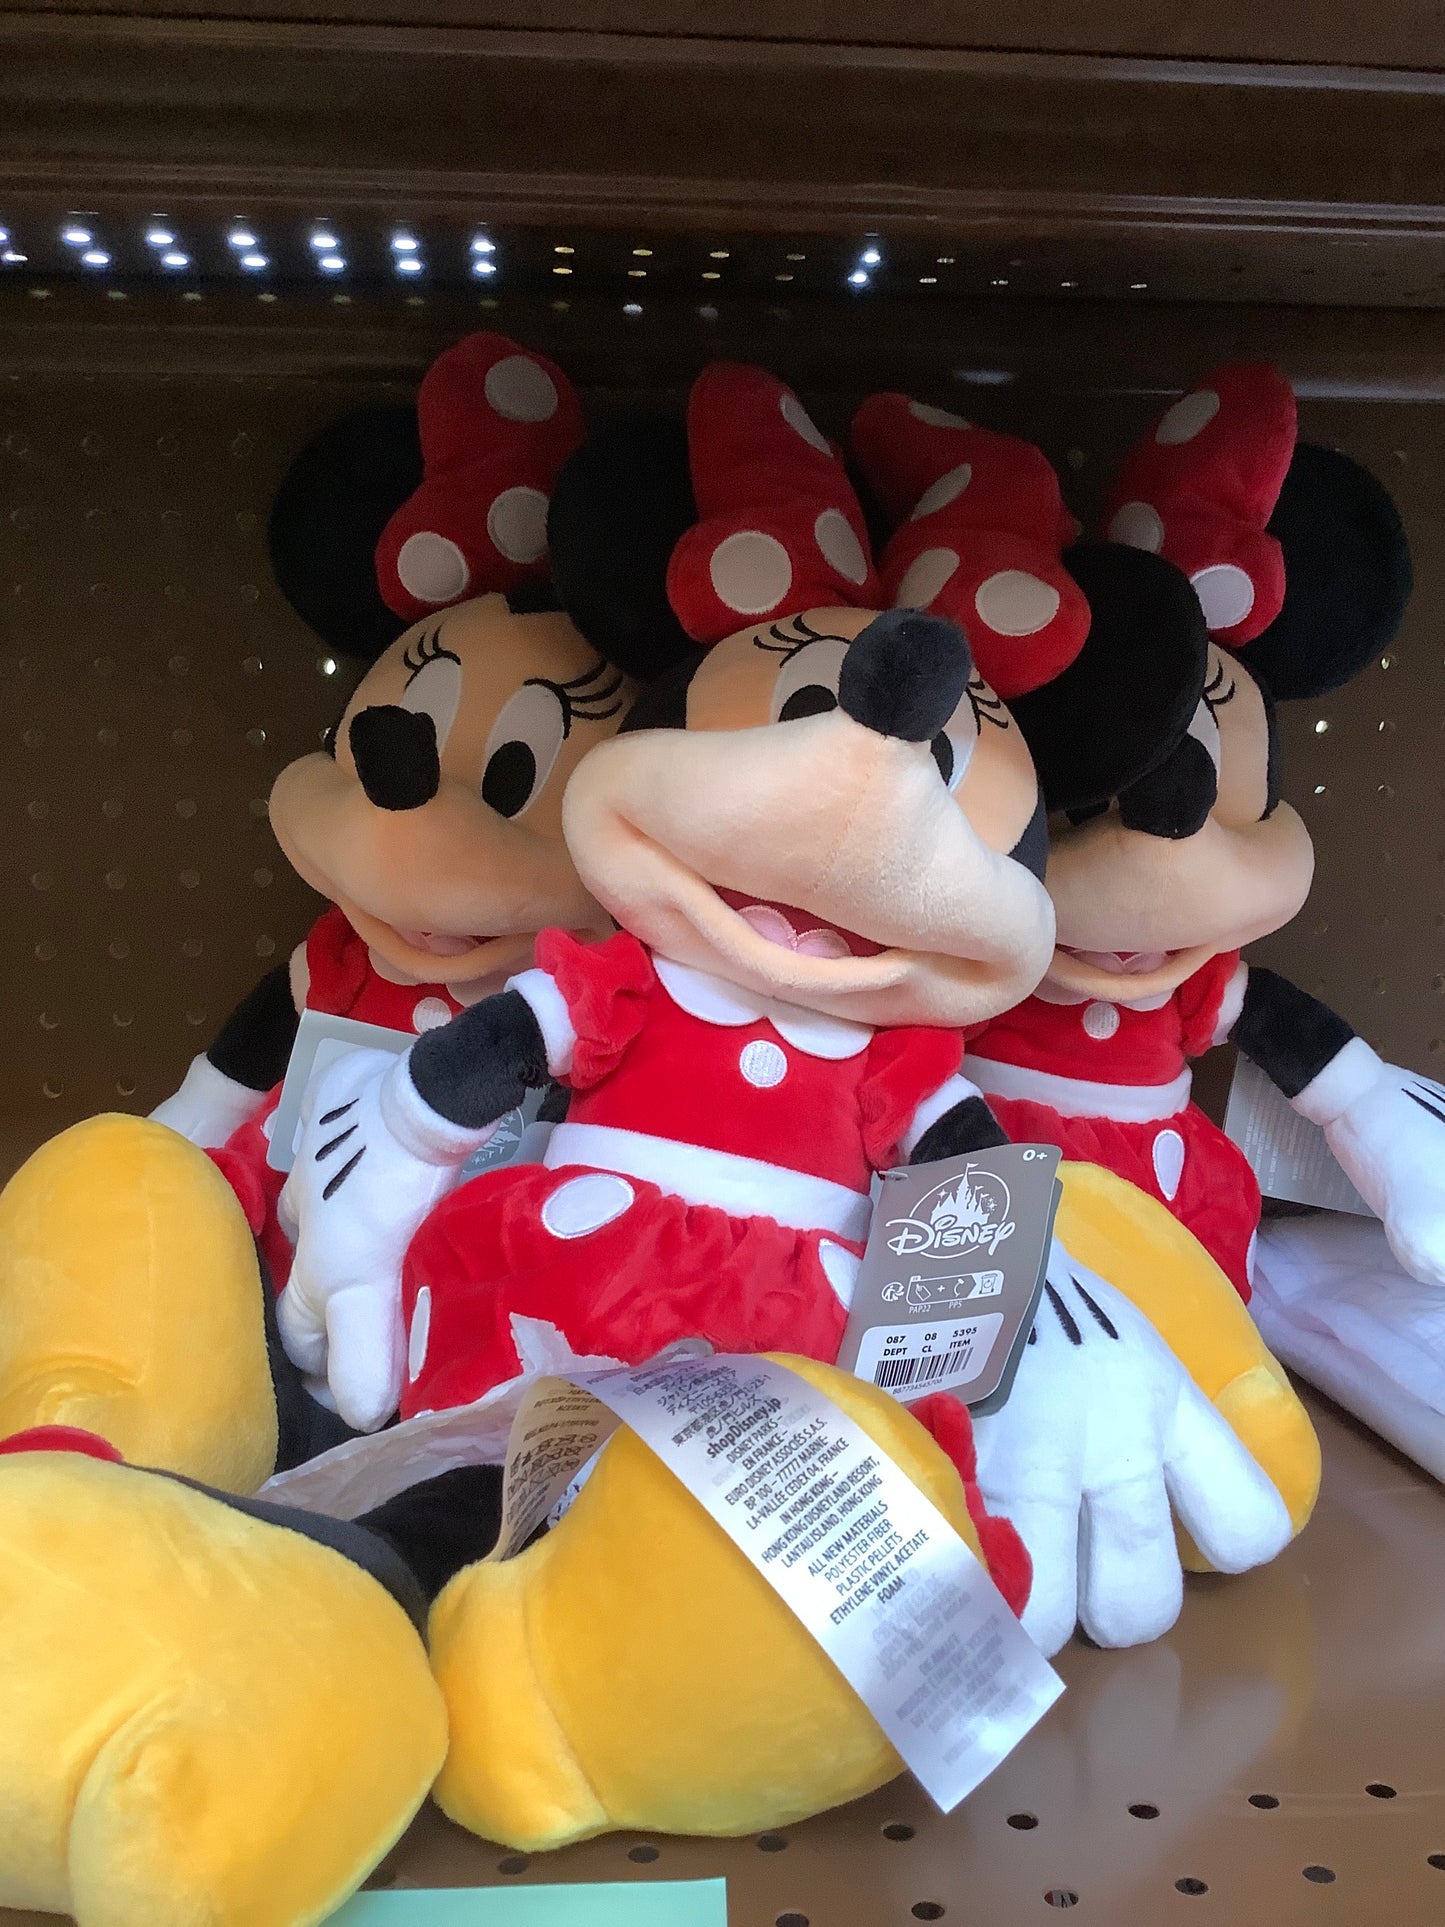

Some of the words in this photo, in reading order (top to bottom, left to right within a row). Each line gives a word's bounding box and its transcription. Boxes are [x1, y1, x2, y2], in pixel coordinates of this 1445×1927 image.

[1022, 1149, 1048, 1161] 0+
[886, 1335, 906, 1344] 087
[924, 1332, 937, 1341] 08
[952, 1327, 978, 1338] 5395
[909, 1305, 931, 1314] PAP22
[883, 1347, 908, 1357] DEPT
[922, 1345, 932, 1353] CL
[949, 1338, 971, 1349] ITEM
[706, 1398, 781, 1459] shopDisney.jp
[726, 1436, 755, 1464] DISNEY
[751, 1418, 779, 1442] PARKS
[741, 1456, 757, 1471] EN
[752, 1432, 785, 1462] FRANCE
[724, 1483, 749, 1506] EURO
[744, 1460, 774, 1489] DISNEY
[803, 1418, 827, 1439] S.A.S.
[743, 1495, 757, 1511] BP
[754, 1483, 773, 1500] 100
[775, 1457, 801, 1483] 77777
[784, 1471, 811, 1496] CEDEX
[817, 1437, 849, 1467] FRANCE
[761, 1537, 788, 1563] HONG
[783, 1518, 808, 1544] KONG
[803, 1481, 851, 1526] DISNEYLAND
[846, 1456, 880, 1486] RESORT,
[779, 1510, 793, 1525] IN
[788, 1492, 815, 1517] HONG
[809, 1474, 835, 1498] KONG
[781, 1536, 814, 1568] LANTAU
[809, 1513, 843, 1542] ISLAND,
[837, 1492, 863, 1517] HONG
[858, 1474, 883, 1499] KONG
[808, 1558, 827, 1577] ALL
[821, 1538, 845, 1562] NEW
[841, 1500, 888, 1545] MATERIALS
[824, 1538, 871, 1582] POLYESTER
[866, 1518, 893, 1544] FIBER
[836, 1560, 872, 1596] PLASTIC
[867, 1531, 903, 1566] PELLETS
[830, 1581, 875, 1625] ETHYLENE
[869, 1561, 899, 1587] VINYL
[894, 1529, 930, 1566] ACETATE
[877, 1575, 906, 1604] FOAM
